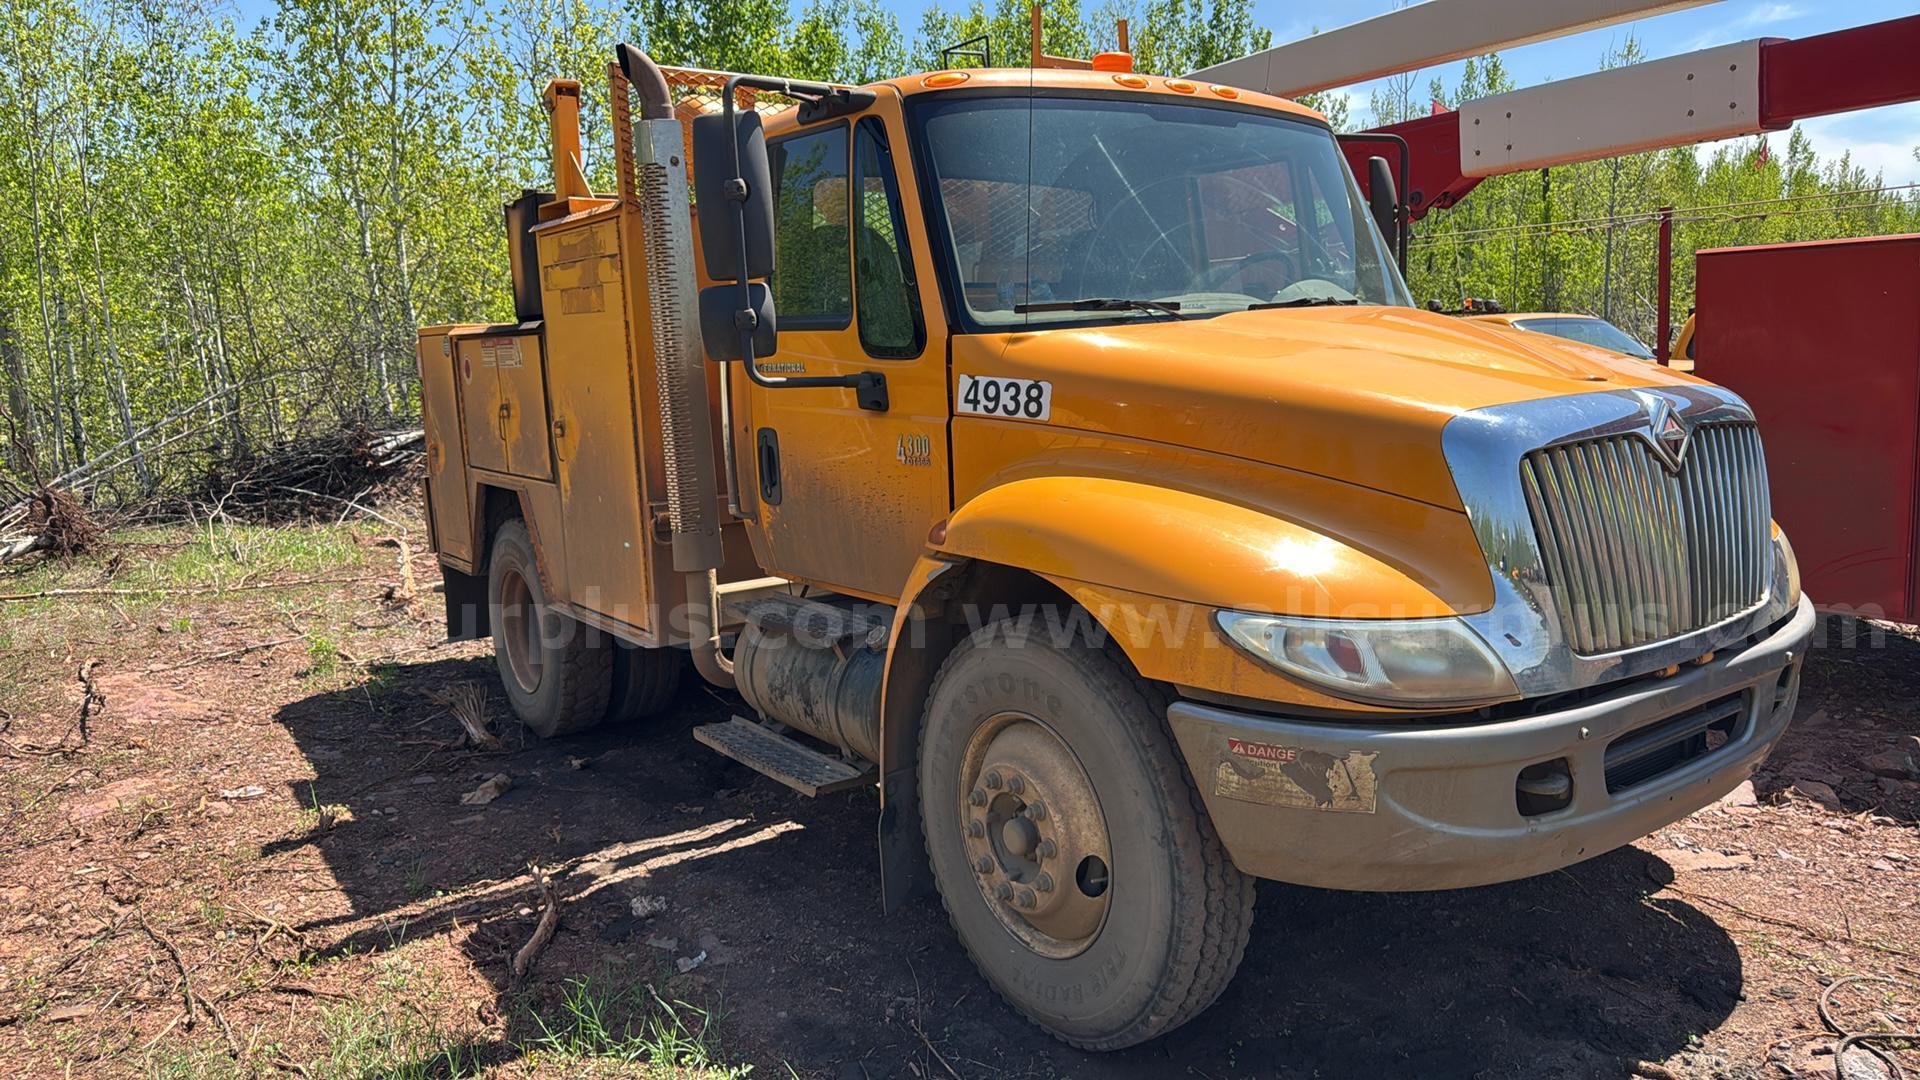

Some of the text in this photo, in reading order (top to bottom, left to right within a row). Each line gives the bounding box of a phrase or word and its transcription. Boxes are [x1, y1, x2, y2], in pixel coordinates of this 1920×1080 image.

[963, 379, 1044, 418] 4938
[896, 433, 931, 464] 4300
[1247, 744, 1297, 761] DANGE
